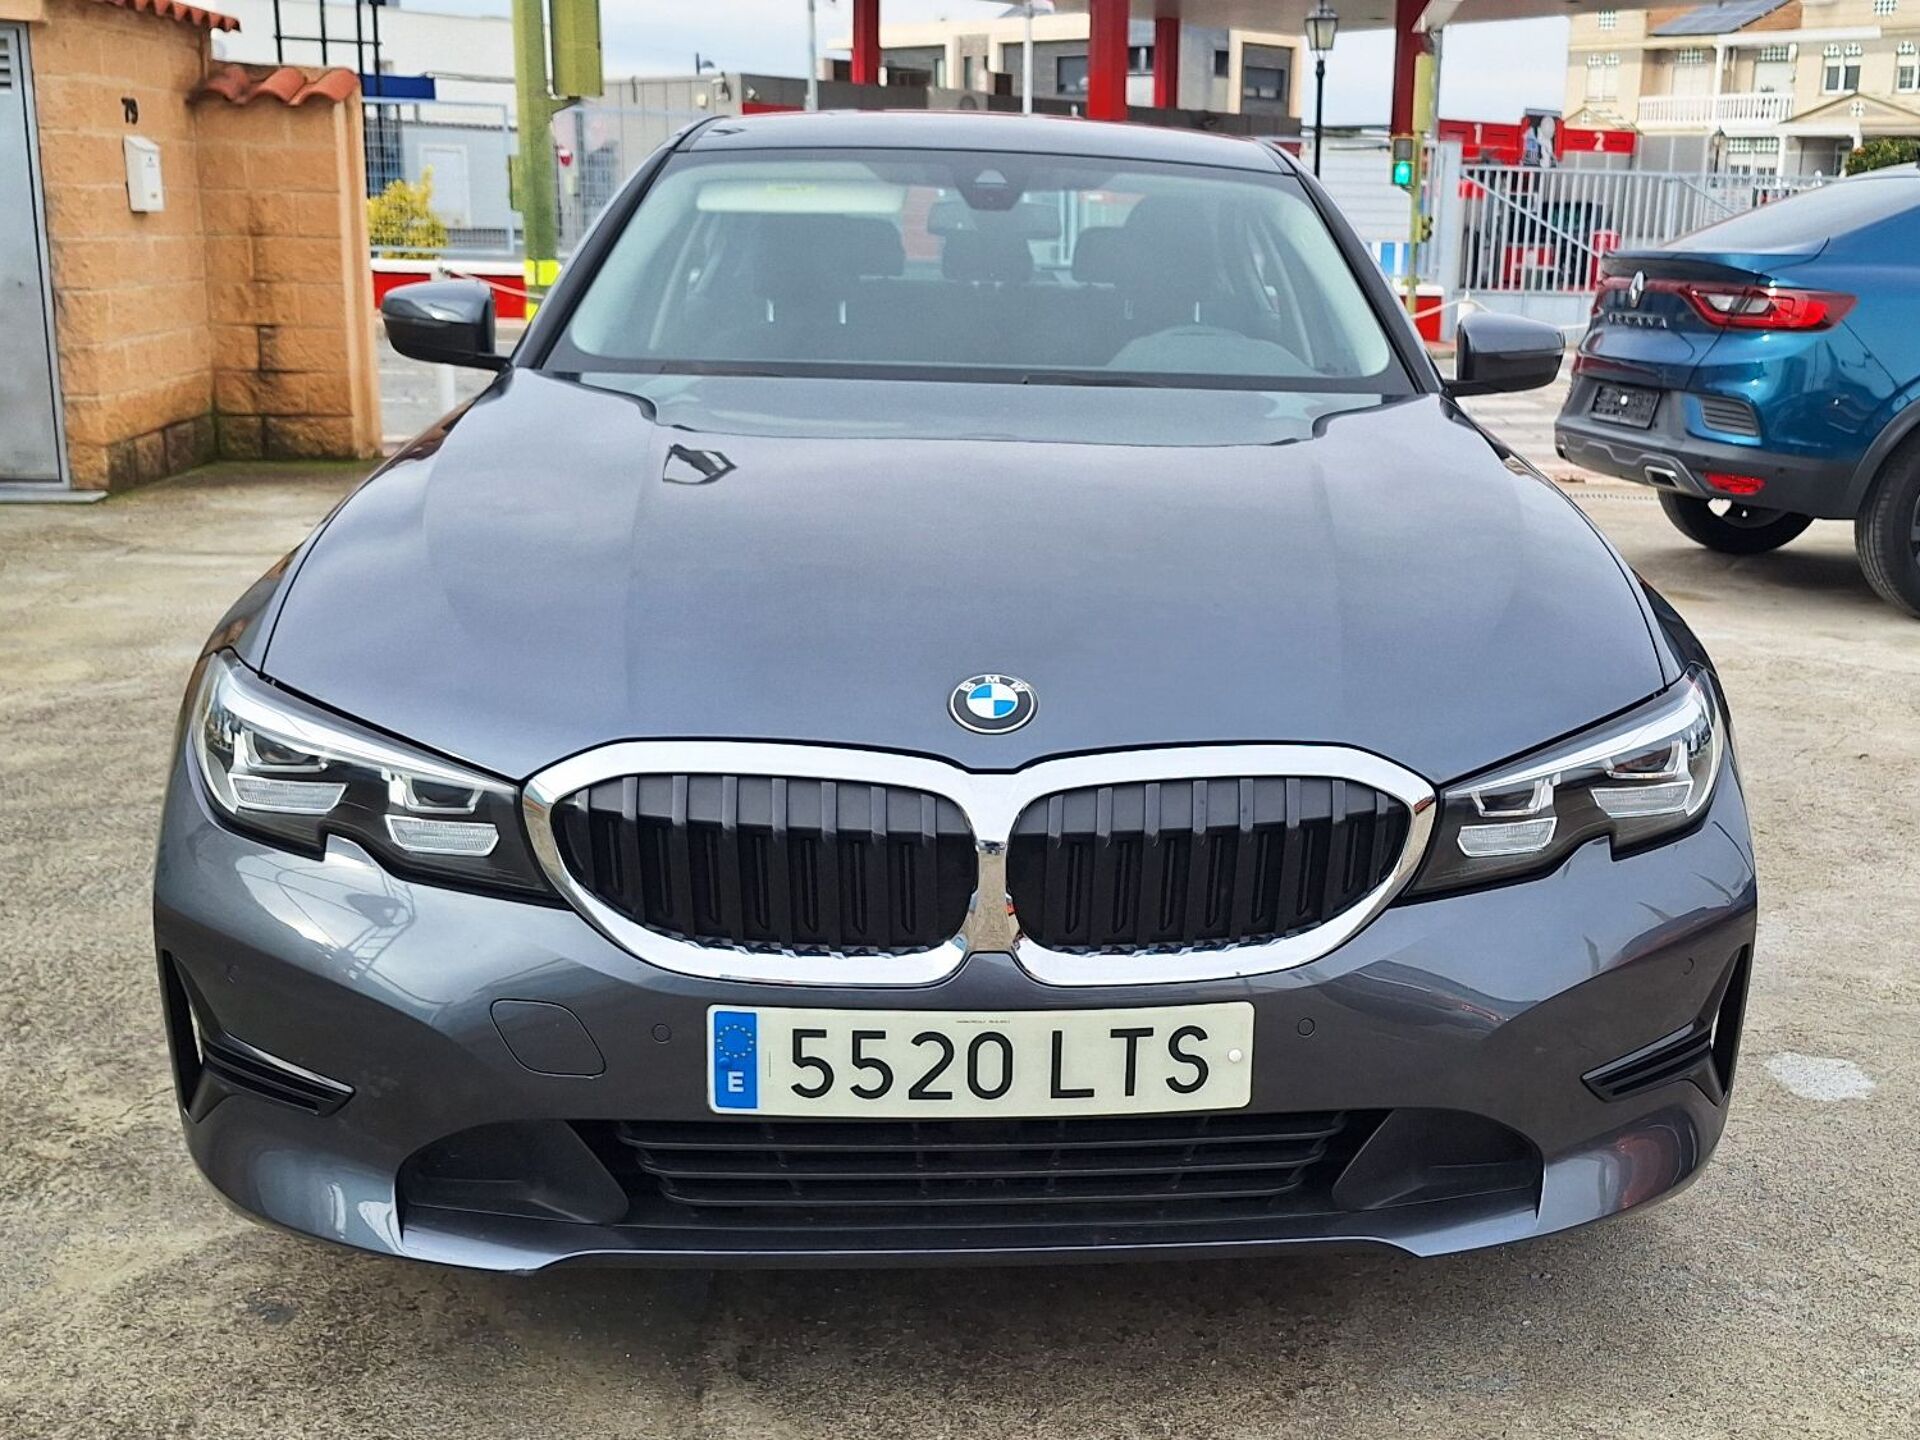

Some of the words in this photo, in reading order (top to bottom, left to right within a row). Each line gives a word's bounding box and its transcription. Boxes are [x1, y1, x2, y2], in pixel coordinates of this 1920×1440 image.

[1473, 123, 1483, 145] 1
[1593, 132, 1605, 151] 2
[791, 1028, 1014, 1101] 5520
[1050, 1025, 1209, 1099] LTS
[727, 1071, 745, 1093] E
